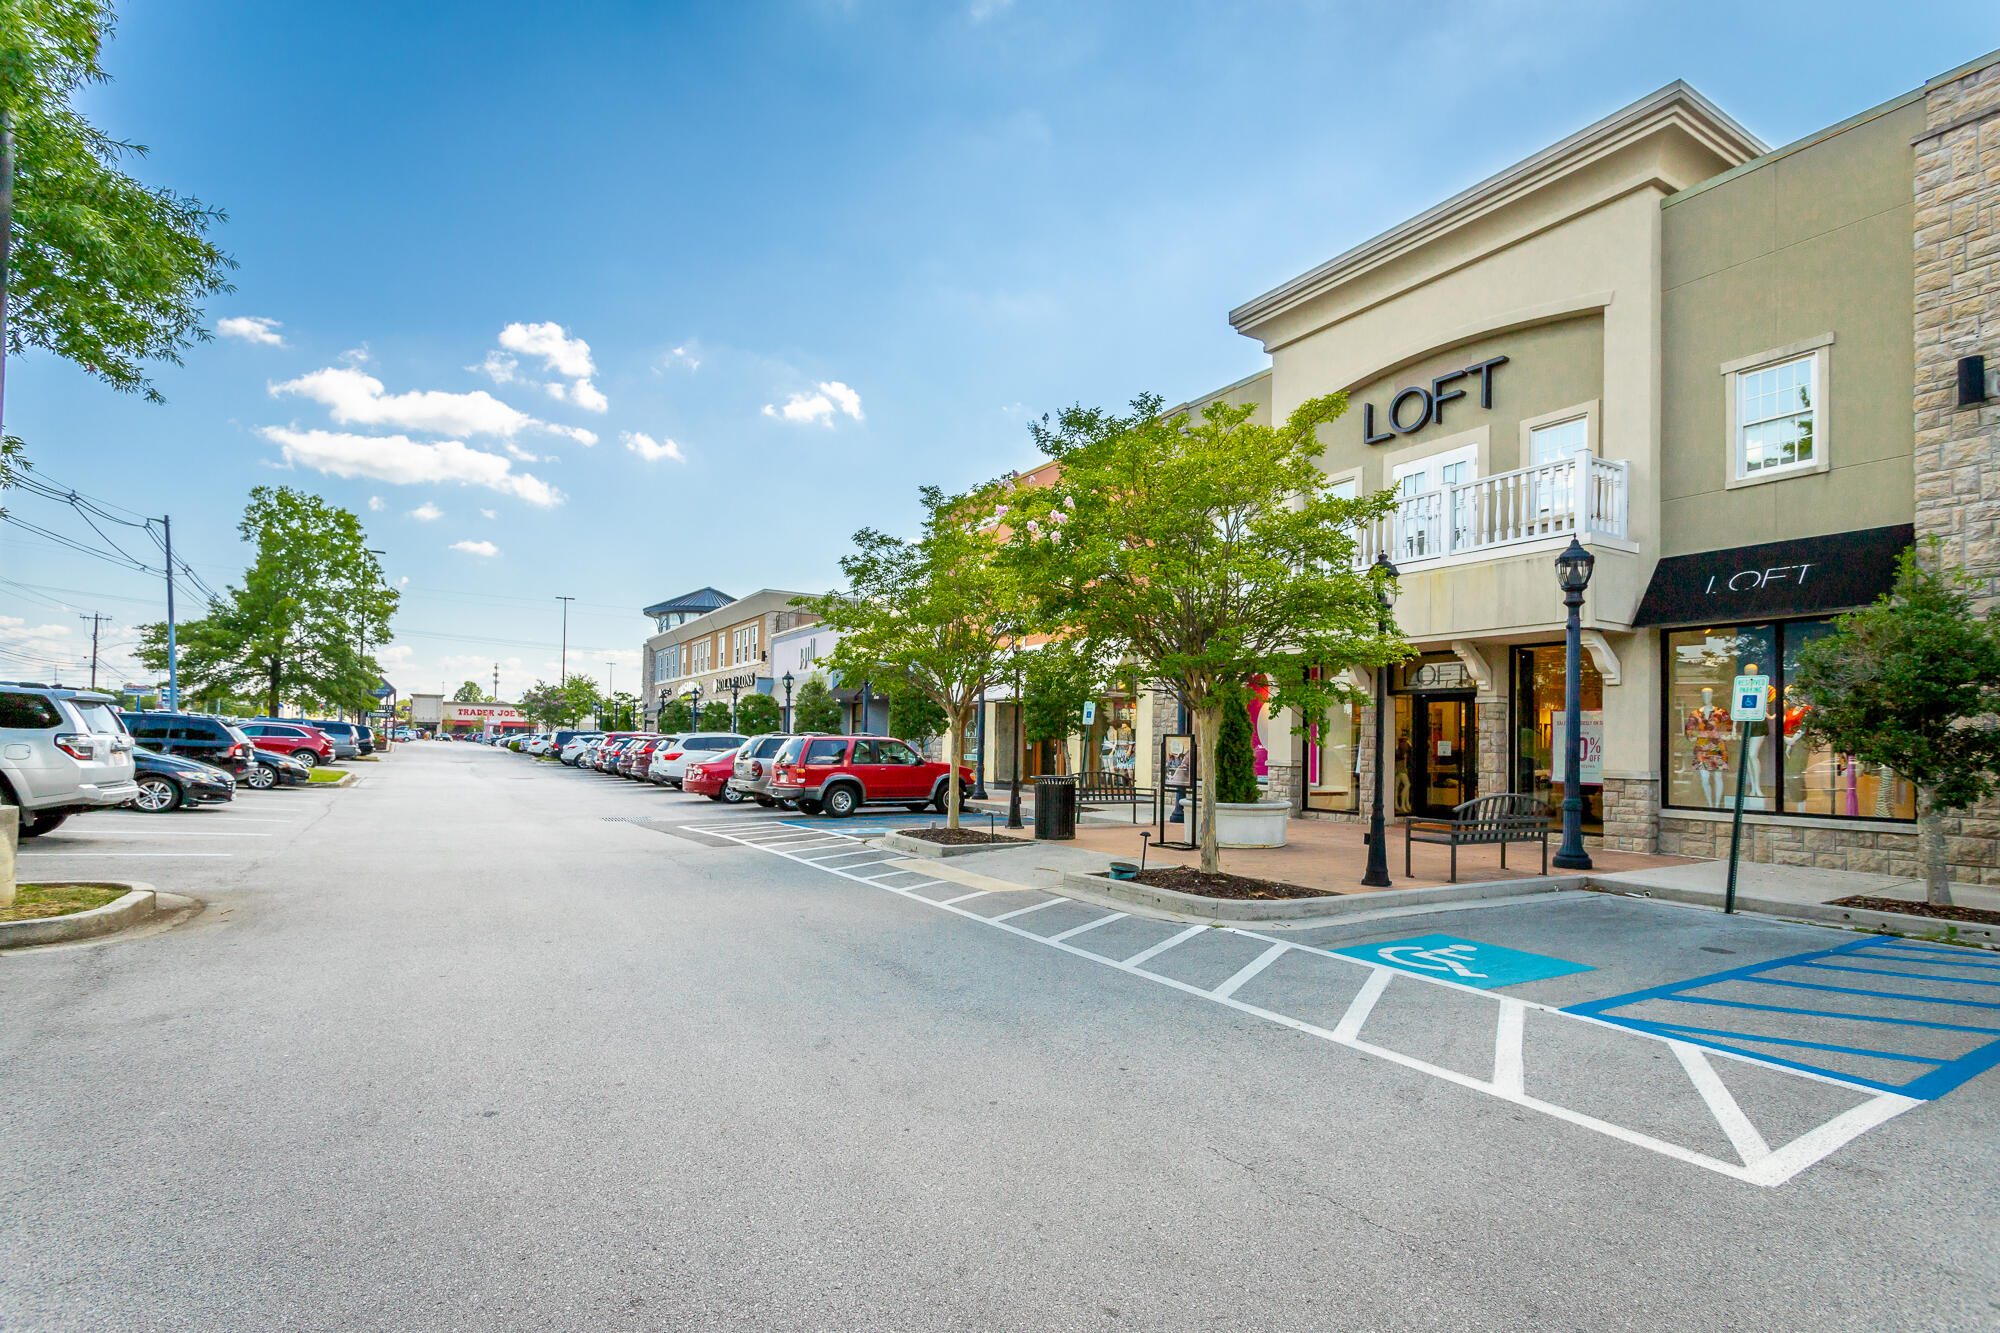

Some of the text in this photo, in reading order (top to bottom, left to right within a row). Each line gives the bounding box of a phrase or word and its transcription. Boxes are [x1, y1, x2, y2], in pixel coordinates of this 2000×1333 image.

[1364, 355, 1510, 444] LOFT
[1706, 563, 1817, 594] LOFT
[1404, 662, 1465, 688] LOFT
[458, 708, 495, 717] TRADER
